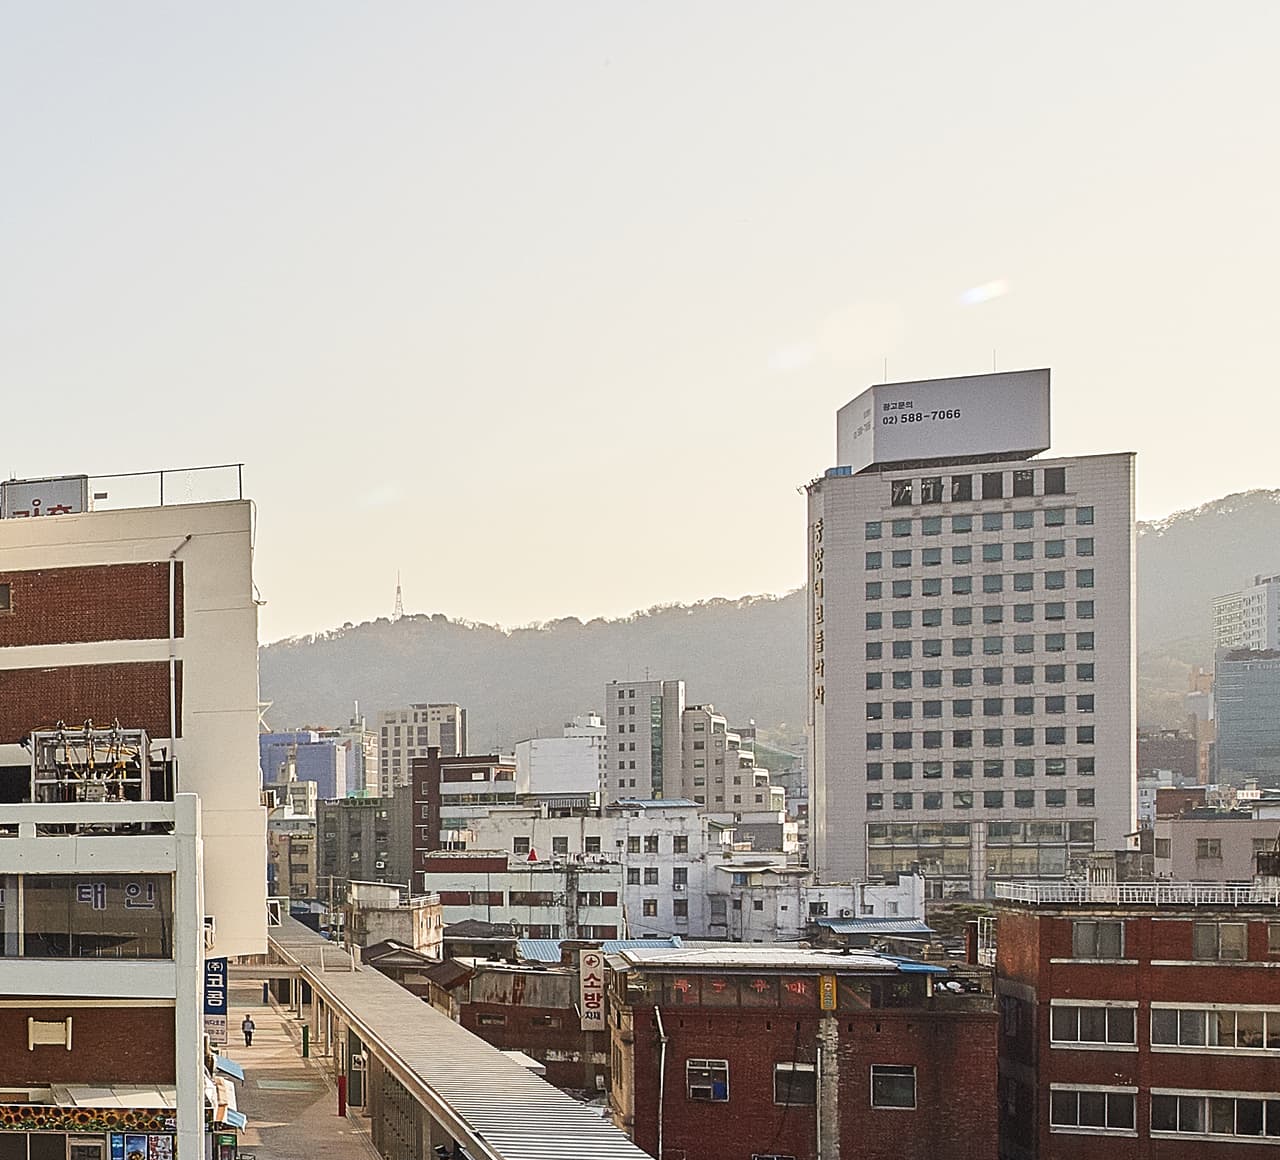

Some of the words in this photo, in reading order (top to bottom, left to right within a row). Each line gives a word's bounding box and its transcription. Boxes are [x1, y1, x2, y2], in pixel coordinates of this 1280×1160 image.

[883, 401, 913, 411] 광고문의
[882, 415, 898, 425] 02)
[900, 409, 961, 423] 588-7066
[76, 882, 156, 910] 태인
[207, 961, 224, 972] (주)
[583, 973, 603, 1009] 소방
